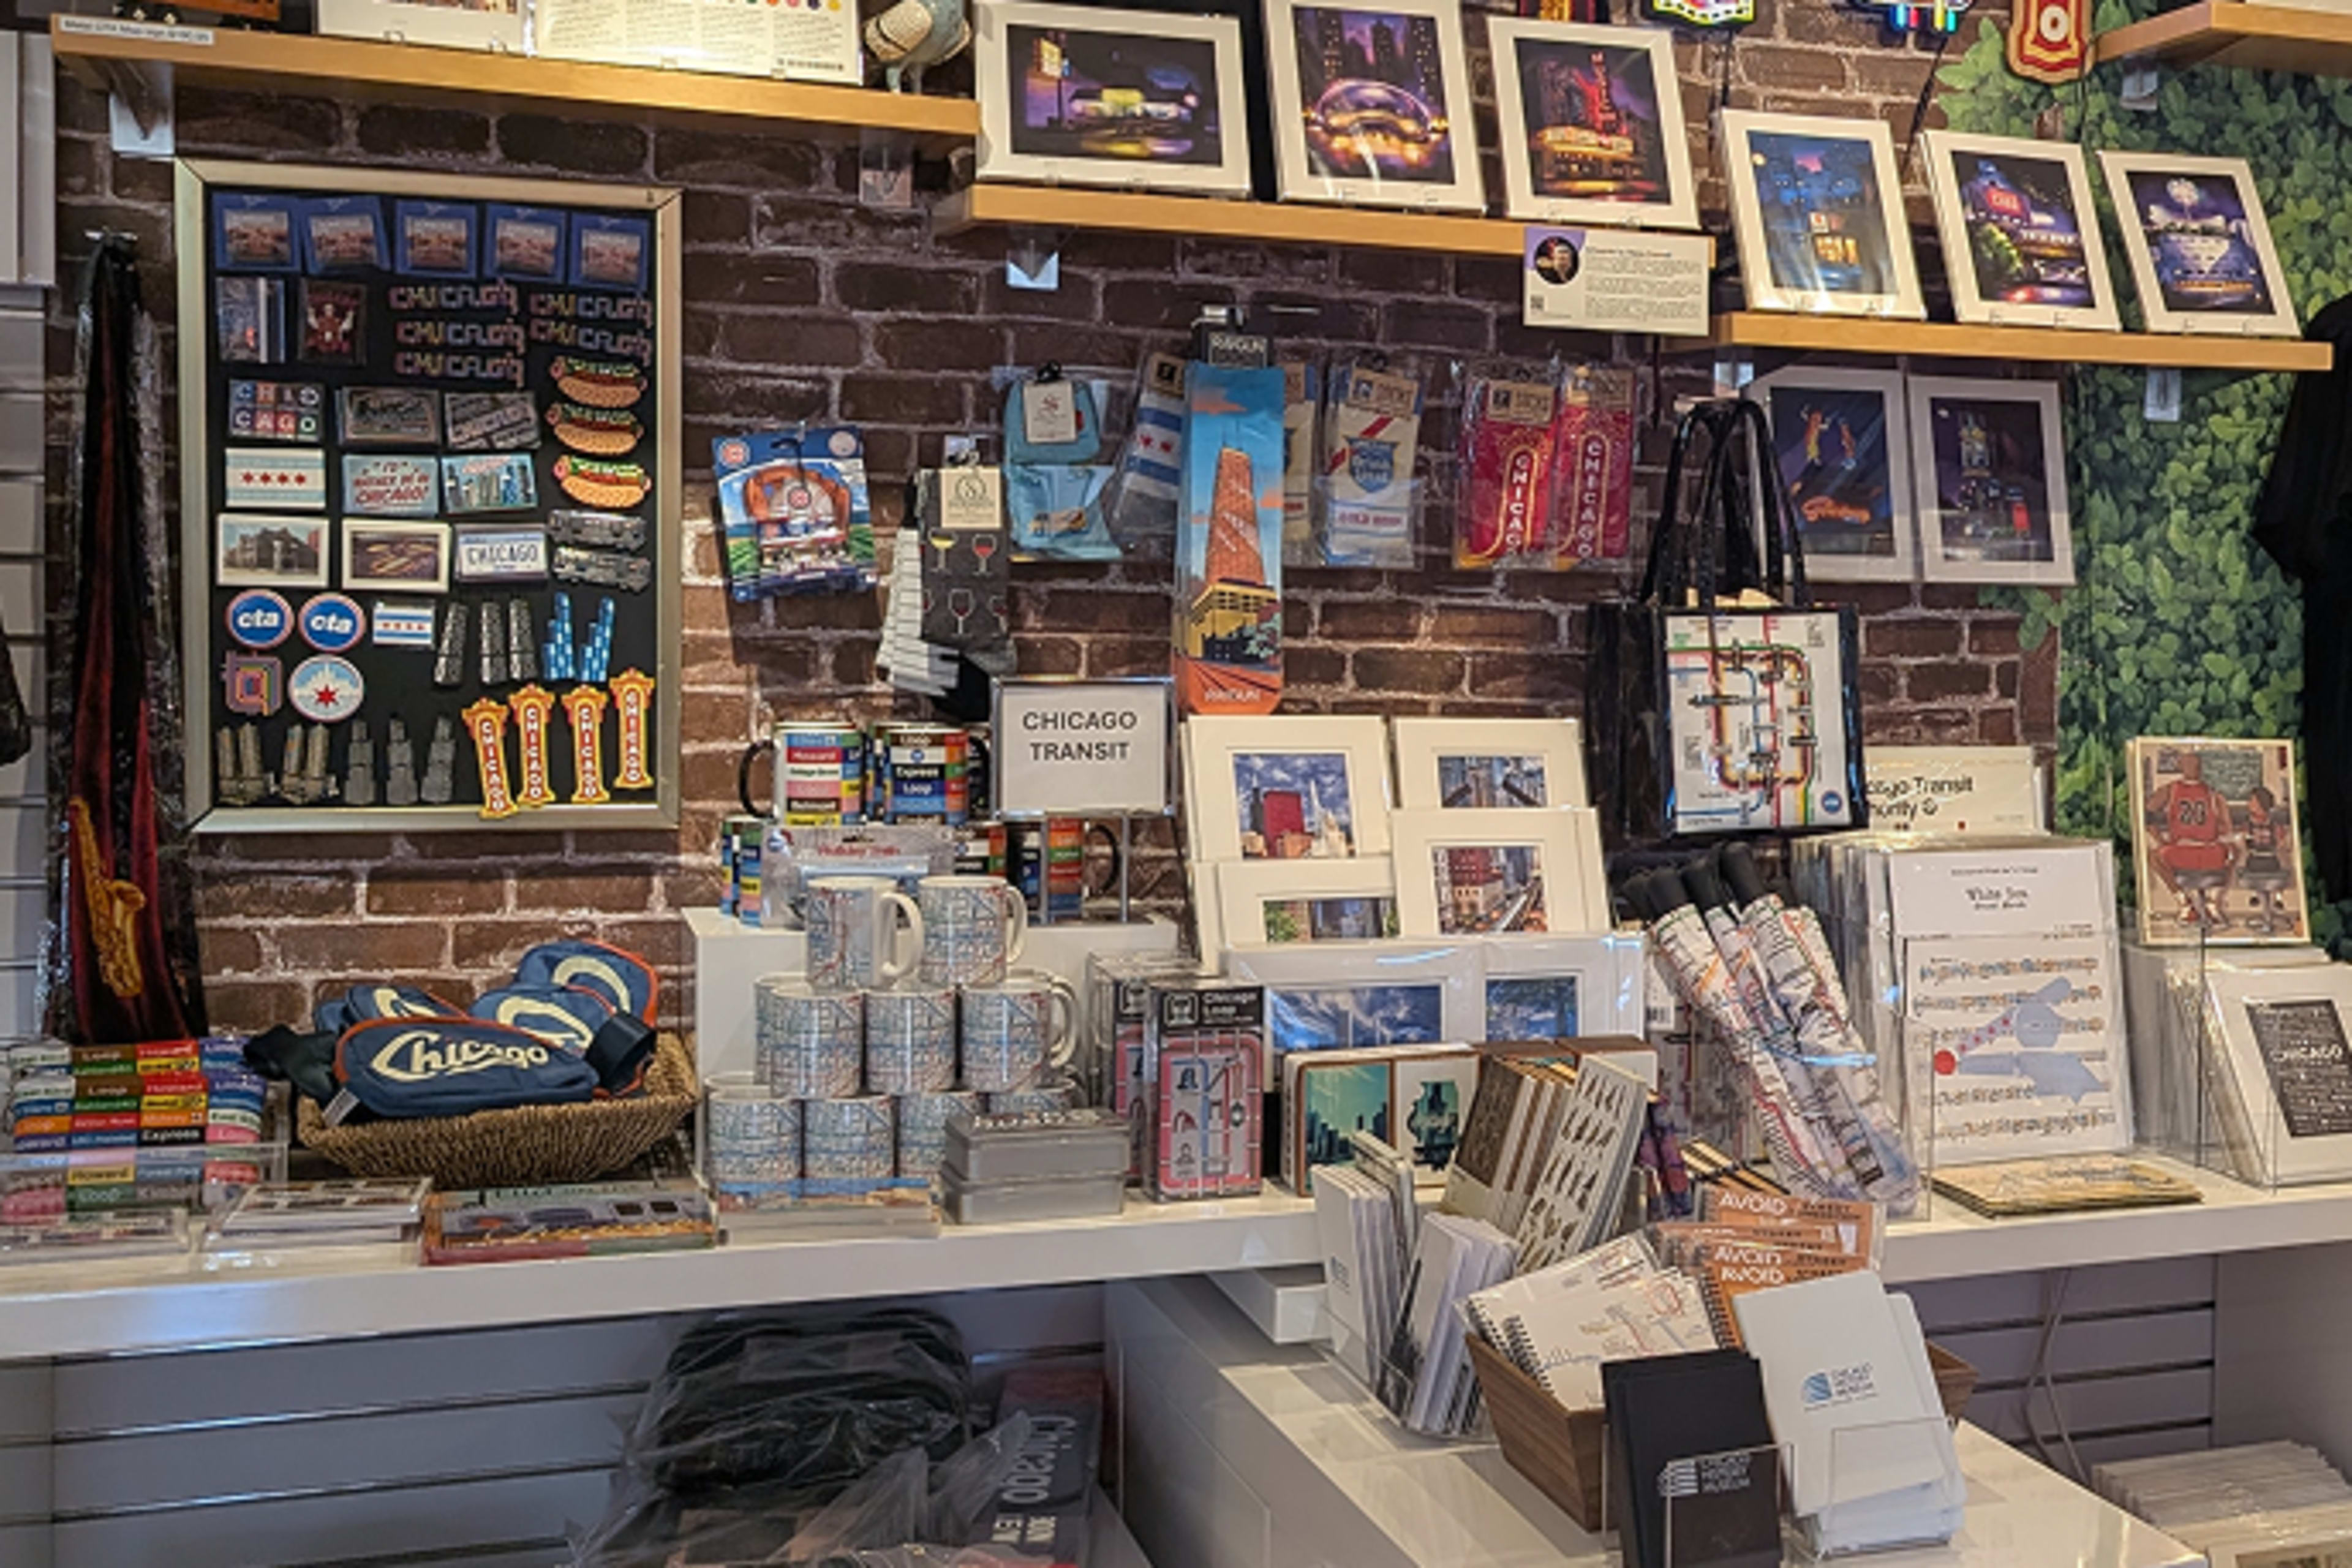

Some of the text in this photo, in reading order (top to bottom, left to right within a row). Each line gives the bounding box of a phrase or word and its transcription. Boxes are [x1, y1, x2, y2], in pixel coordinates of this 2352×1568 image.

[1578, 441, 1602, 558] CHICAGO
[466, 543, 540, 565] CHICAGO
[236, 608, 280, 628] cta
[310, 612, 353, 635] cta
[1022, 711, 1137, 731] CHICAGO
[626, 692, 641, 782] CHICAGO
[526, 707, 543, 799] CHICAGO
[581, 707, 597, 798] CHICAGO
[1030, 742, 1130, 761] TRANSIT
[481, 721, 505, 810] CHICAGO
[895, 766, 939, 779] Express
[903, 783, 933, 795] Loop
[1913, 775, 1973, 796] Transit
[818, 843, 866, 859] Holiday
[1202, 992, 1257, 1005] Chicago
[371, 1030, 550, 1082] Chicago
[141, 1128, 200, 1141] Express
[1719, 1191, 1788, 1216] AVOID
[1701, 1476, 1751, 1493] MUSEUM
